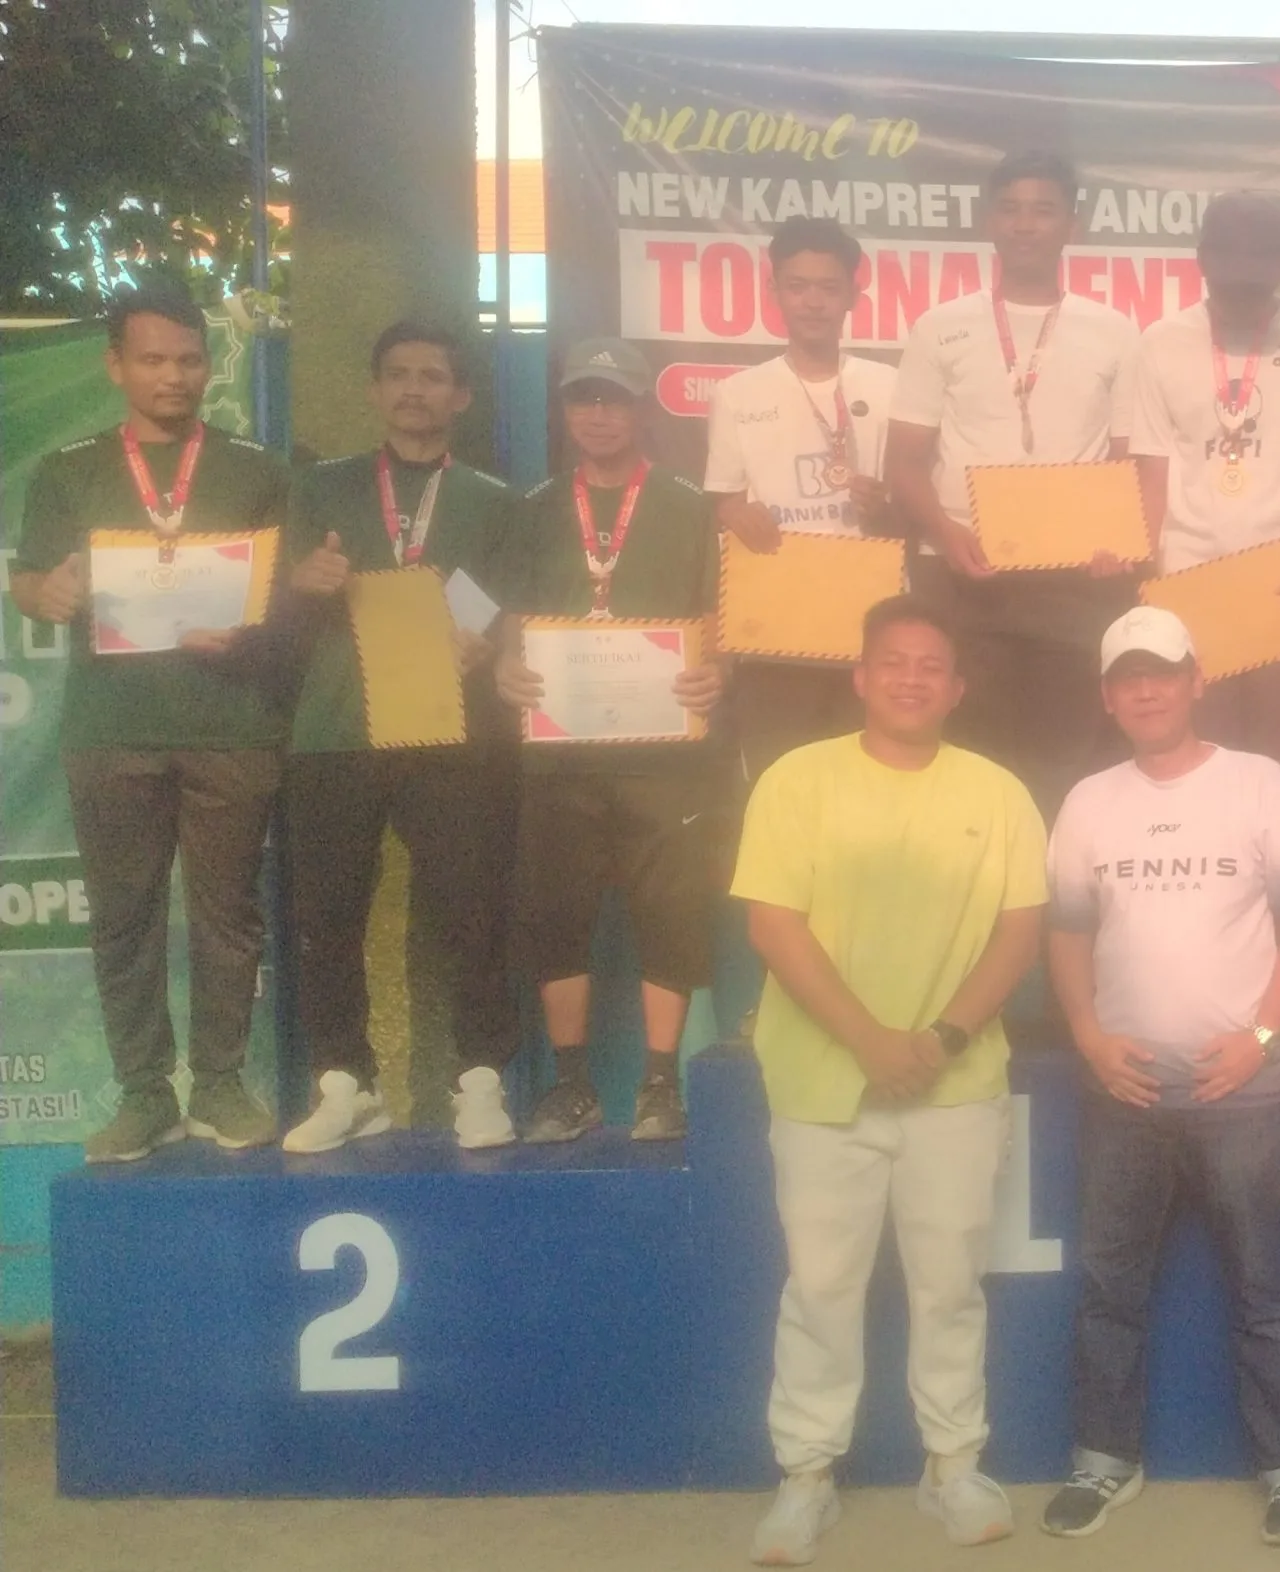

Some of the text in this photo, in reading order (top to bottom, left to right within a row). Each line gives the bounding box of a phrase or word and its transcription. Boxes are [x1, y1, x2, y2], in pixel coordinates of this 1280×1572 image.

[866, 116, 919, 159] TO
[617, 171, 730, 220] NEW
[740, 176, 980, 229] KAMPRET
[769, 504, 824, 525] BANK
[1093, 857, 1238, 883] TENNIS
[299, 1212, 399, 1392] 2
